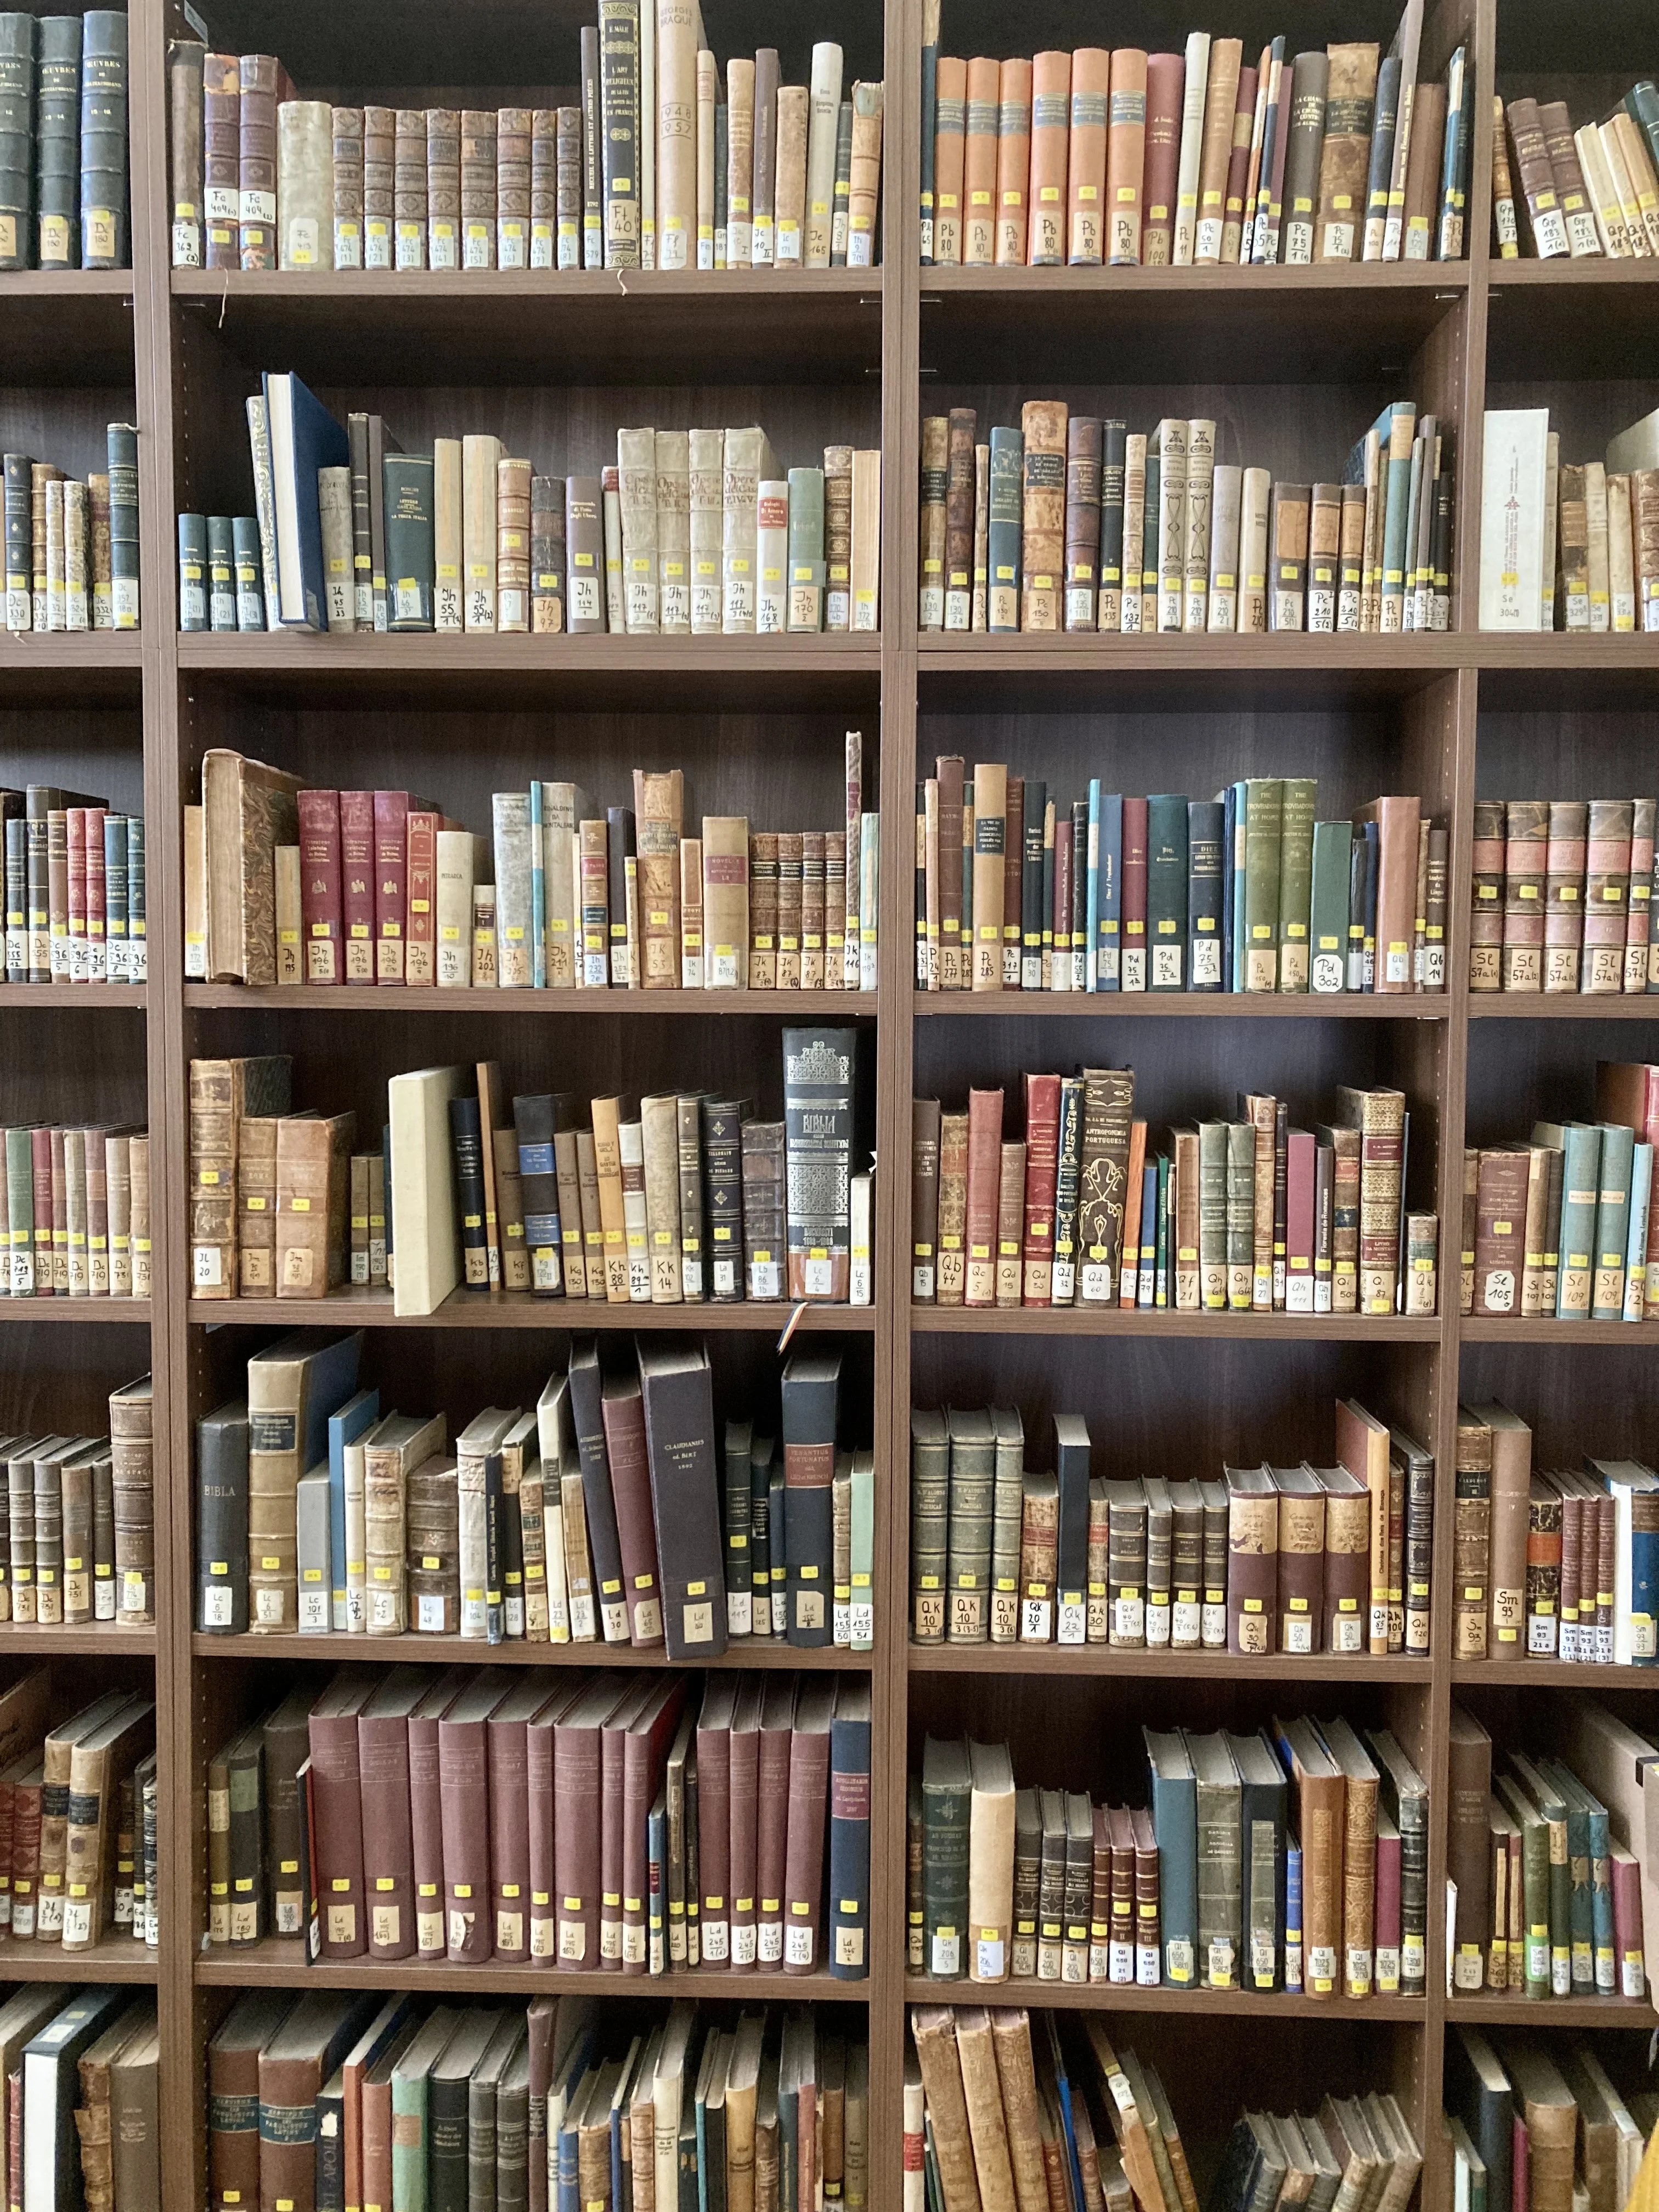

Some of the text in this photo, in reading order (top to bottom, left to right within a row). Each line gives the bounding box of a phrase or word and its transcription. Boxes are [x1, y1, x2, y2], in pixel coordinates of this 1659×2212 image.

[661, 15, 692, 27] BRAQUE
[1043, 220, 1057, 235] Pb
[1118, 221, 1132, 236] Pb
[1045, 237, 1054, 248] 80
[1121, 238, 1131, 248] 80
